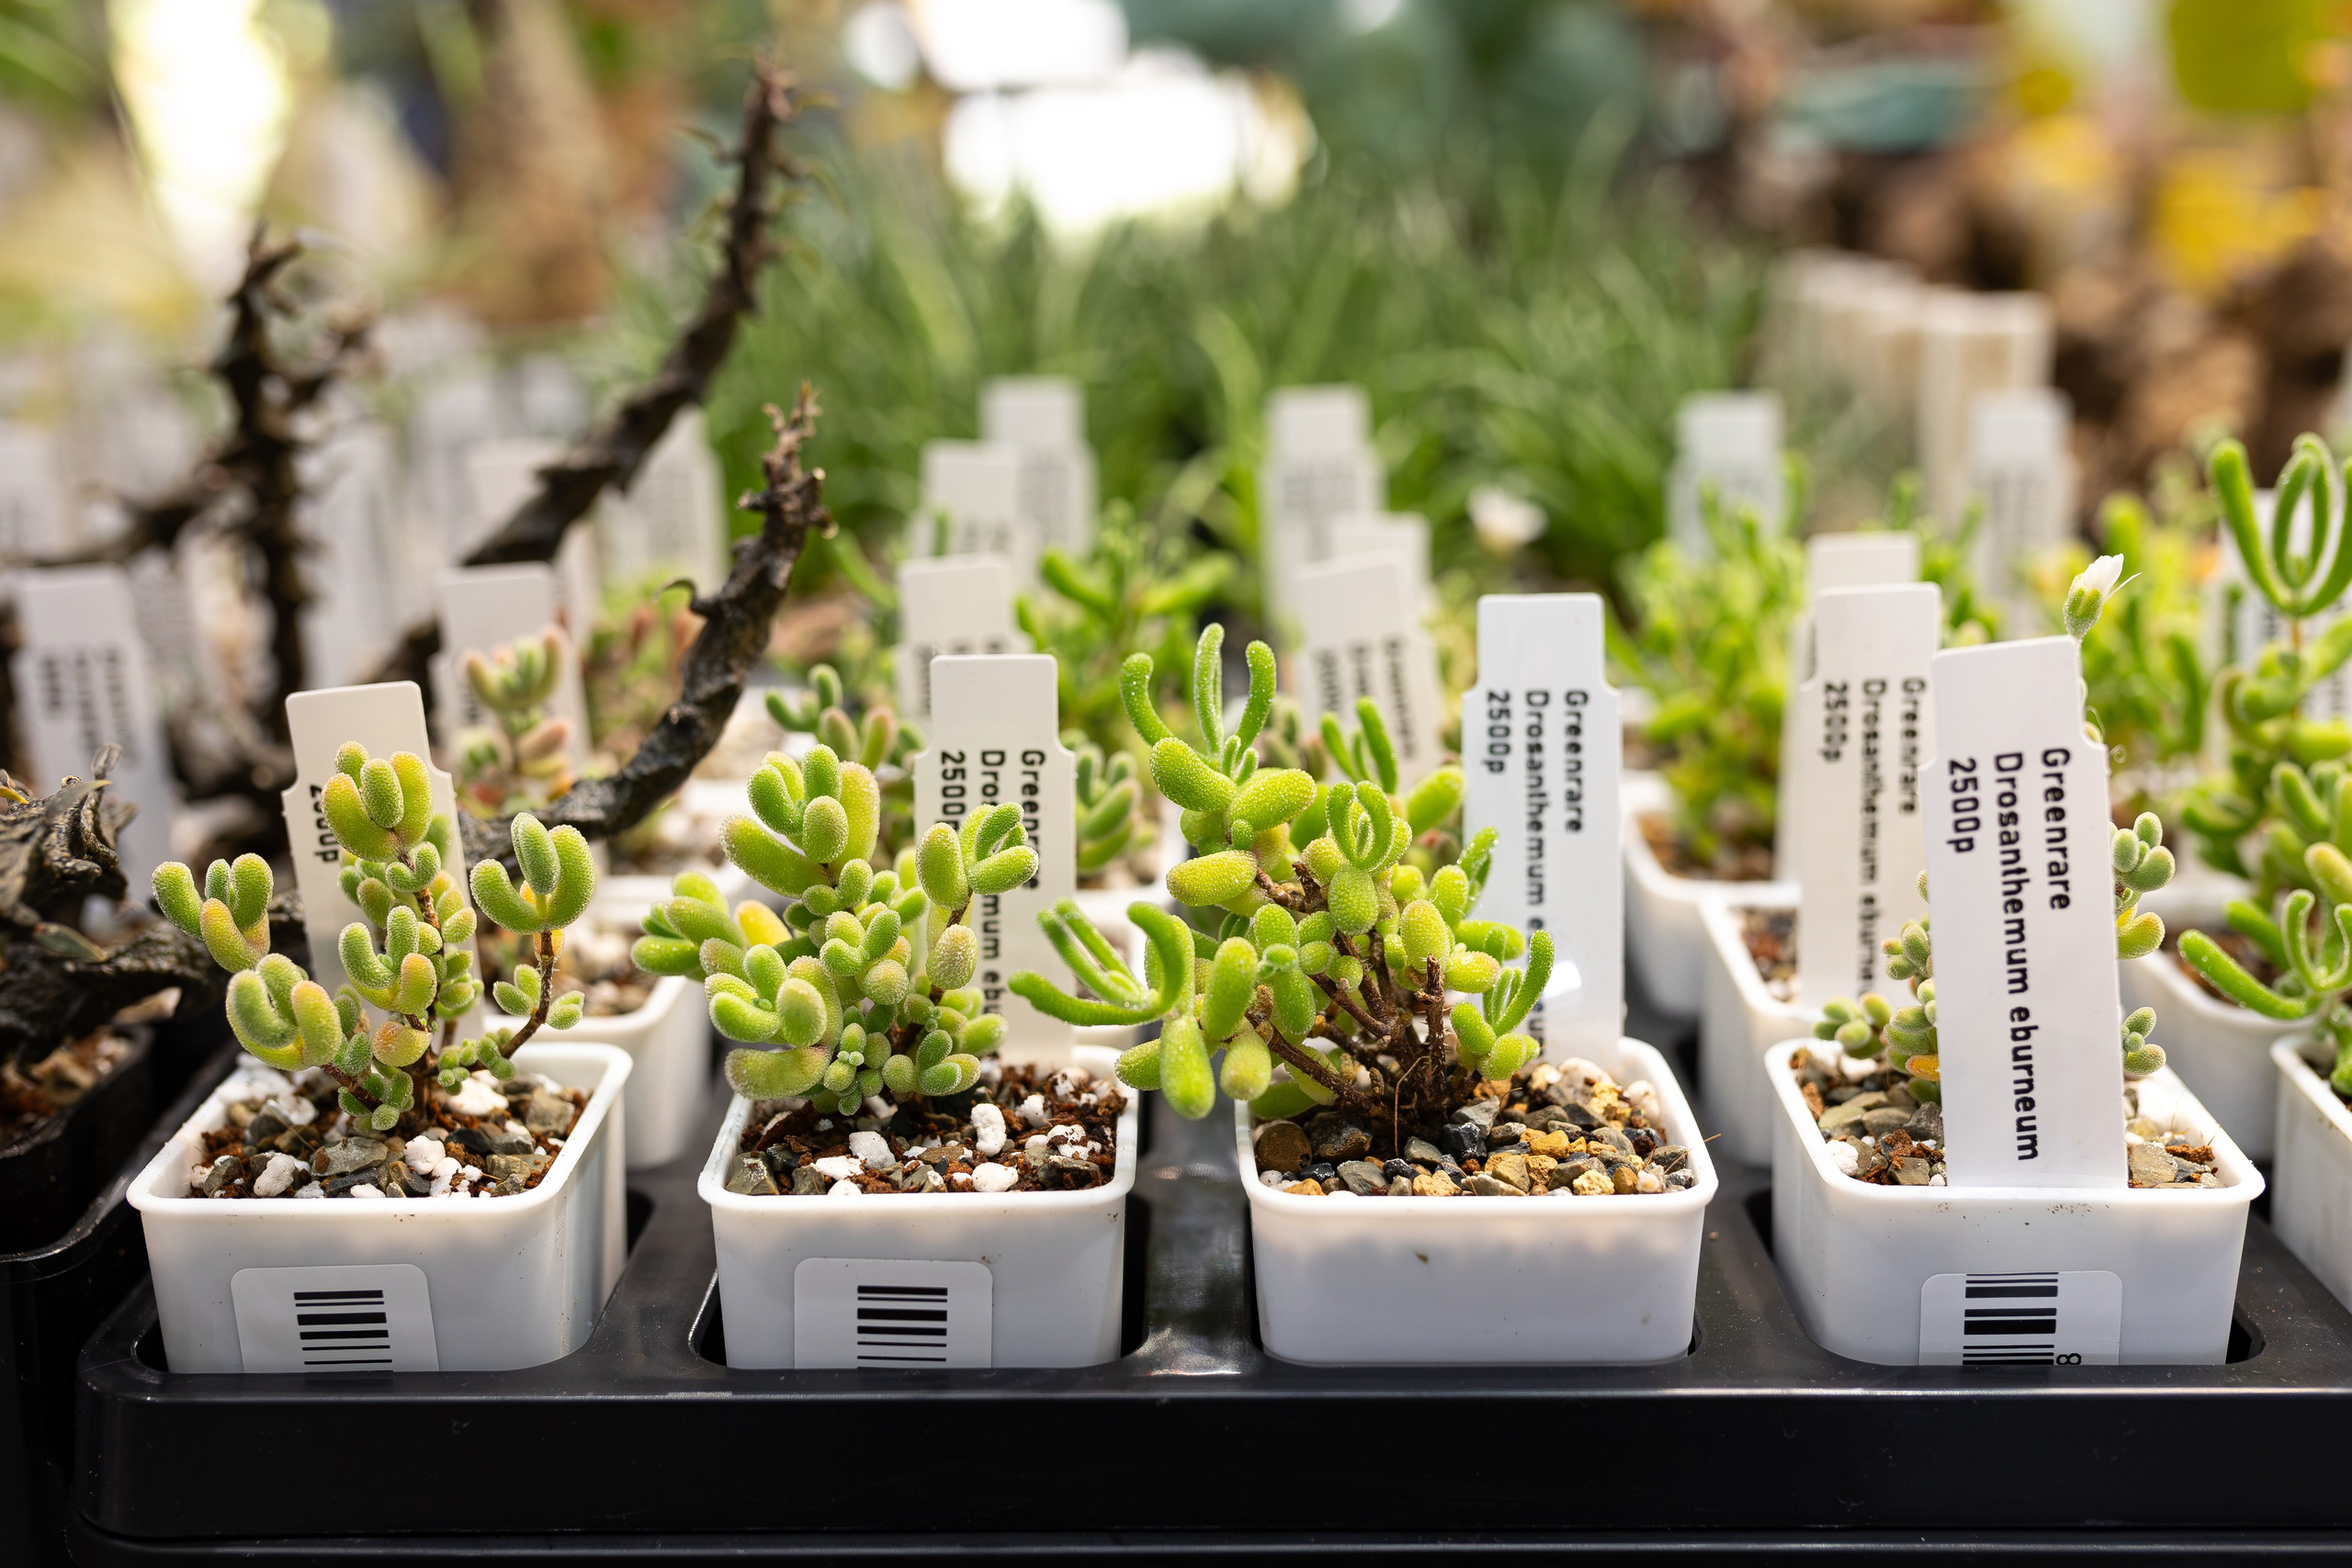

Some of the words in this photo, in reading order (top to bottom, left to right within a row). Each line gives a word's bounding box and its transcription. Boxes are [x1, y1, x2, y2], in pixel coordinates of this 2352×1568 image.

[1481, 690, 1511, 775] 2500p
[1525, 690, 1552, 908] Drosanthemum
[1565, 689, 1590, 834] Greenrare
[1946, 757, 1982, 854] 2500p
[1021, 750, 1046, 891] Greenre
[1994, 750, 2031, 996] Drosanthemum
[2041, 747, 2072, 911] Greenrare
[2008, 1005, 2040, 1162] eburneum
